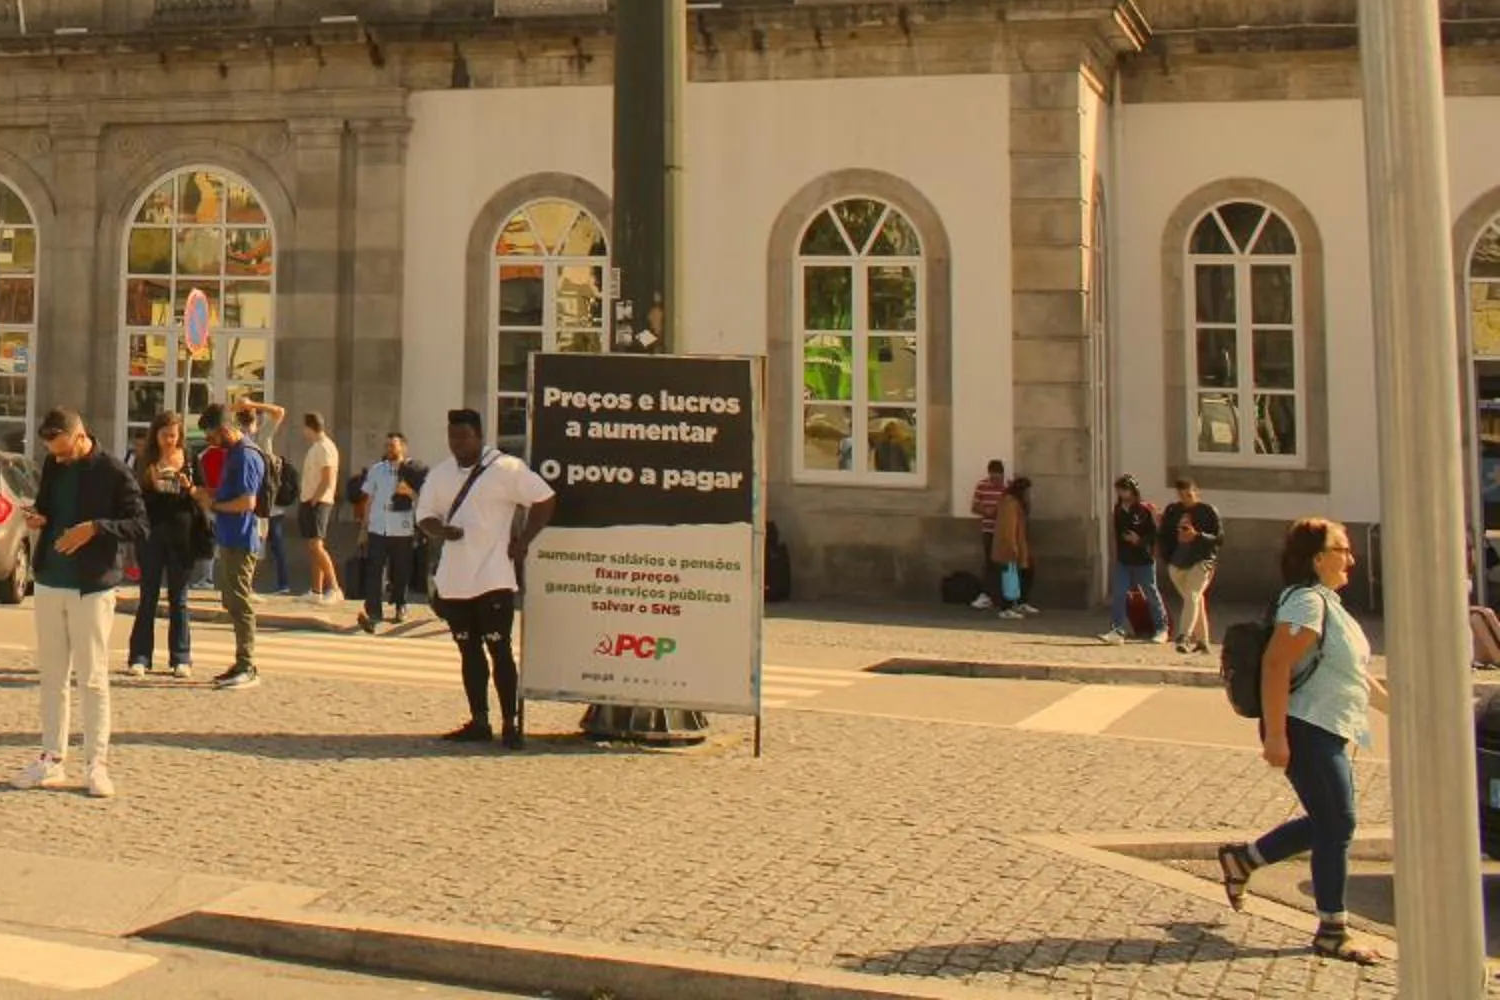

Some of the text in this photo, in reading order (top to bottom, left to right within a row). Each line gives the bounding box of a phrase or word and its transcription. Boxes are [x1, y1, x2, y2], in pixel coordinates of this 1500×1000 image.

[543, 386, 741, 414] Preços e lucros
[565, 420, 718, 443] a aumentar
[539, 459, 743, 491] O povo a pagar
[537, 550, 606, 563] aumentar
[668, 557, 677, 567] e
[680, 557, 741, 572] pensões
[595, 566, 680, 584] fixar preços
[545, 582, 602, 595] garantir
[591, 600, 681, 616] salvar o SNS
[614, 633, 677, 660] PCP
